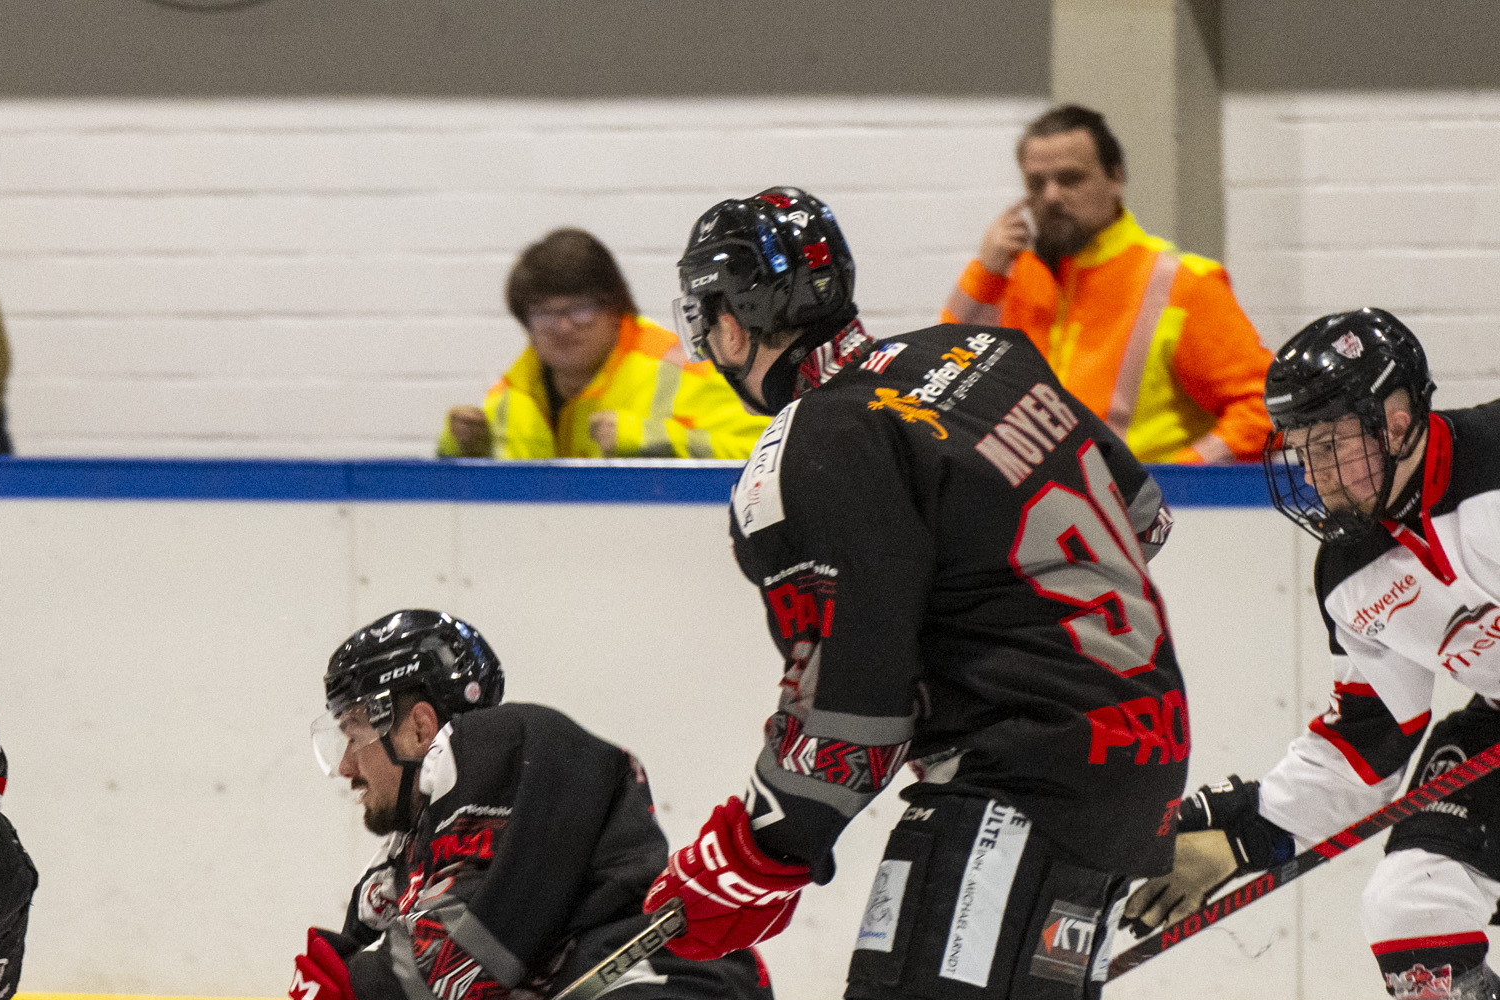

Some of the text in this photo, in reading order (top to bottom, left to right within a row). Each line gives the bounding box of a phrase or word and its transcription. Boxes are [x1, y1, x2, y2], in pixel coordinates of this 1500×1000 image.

[691, 272, 719, 289] CCM
[975, 382, 1080, 488] MOYER
[379, 660, 421, 685] CCM
[1161, 873, 1274, 951] NOVIUM
